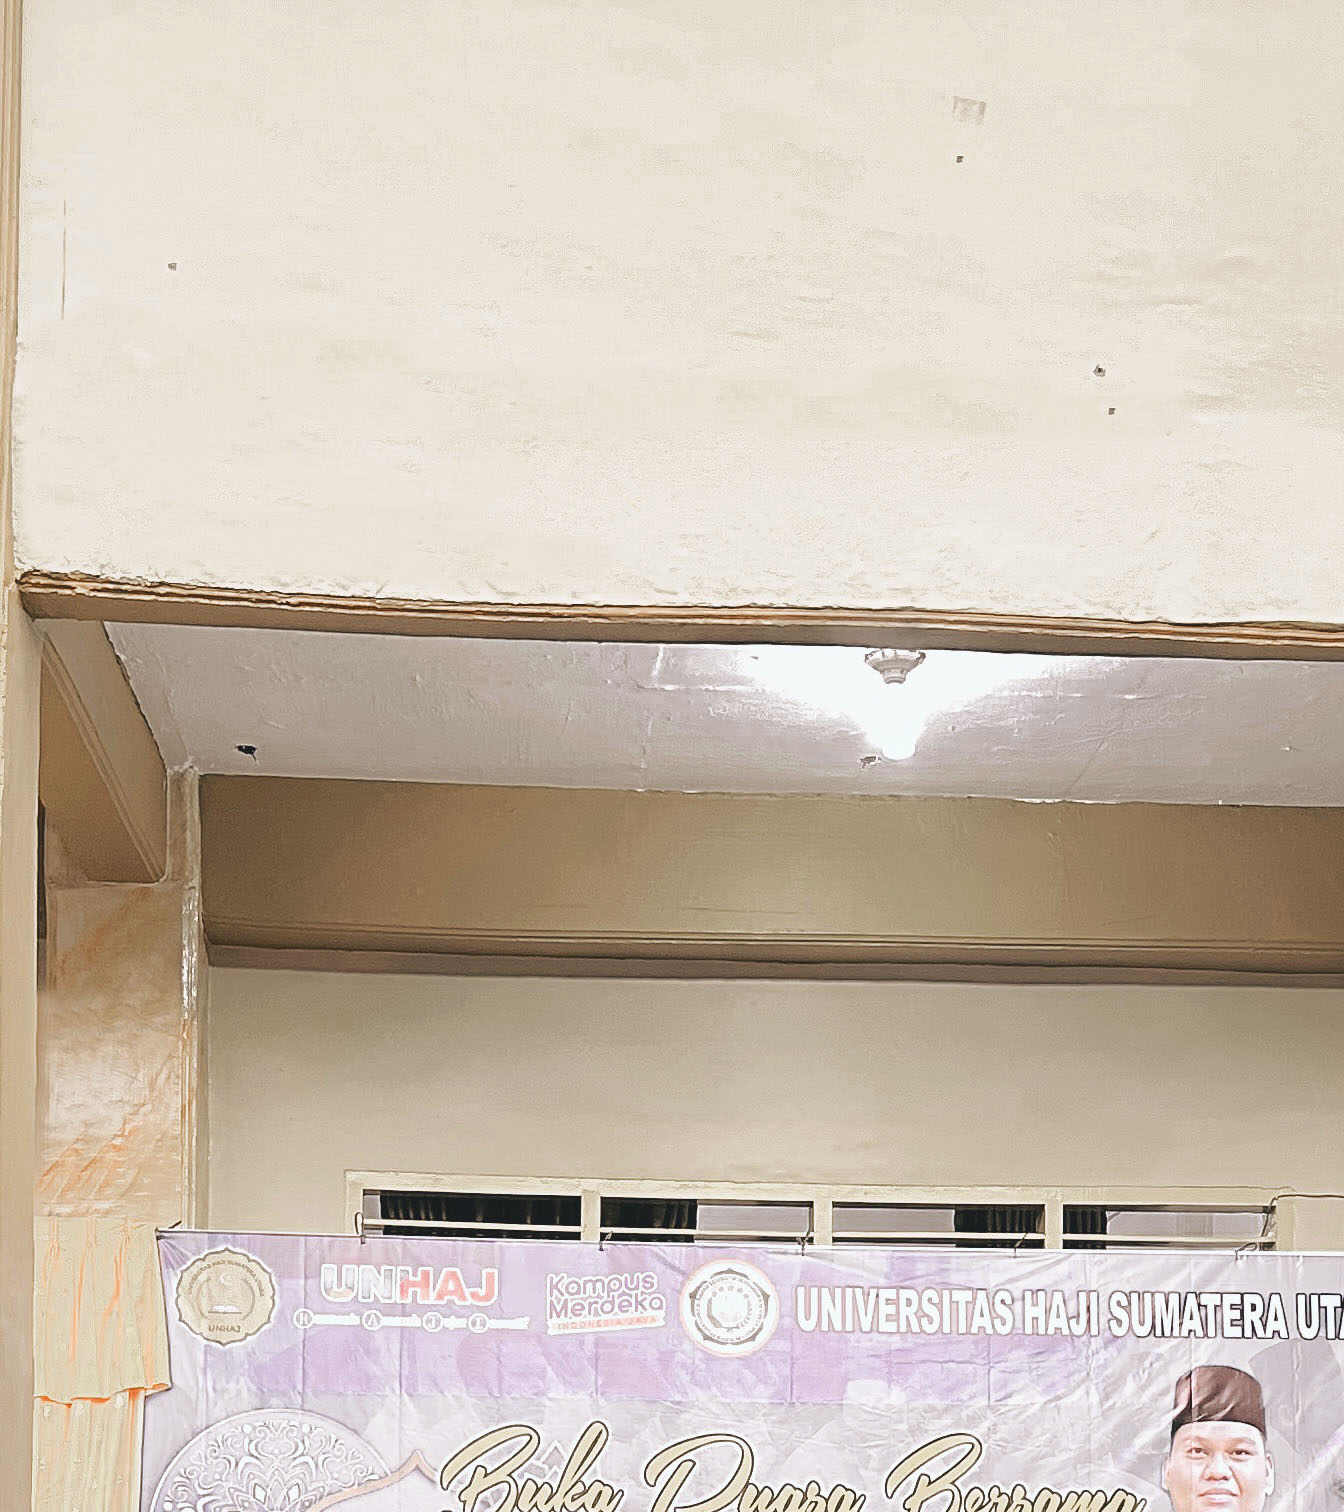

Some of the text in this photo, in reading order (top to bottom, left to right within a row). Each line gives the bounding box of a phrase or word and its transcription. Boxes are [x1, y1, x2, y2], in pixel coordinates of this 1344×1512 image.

[321, 1264, 498, 1306] UNHAJ
[548, 1273, 657, 1300] Kampus
[548, 1292, 664, 1319] Merdeka
[795, 1286, 1014, 1336] UNIVERSITAS
[1022, 1290, 1099, 1339] HAJI
[1107, 1291, 1289, 1340] SUMATERA
